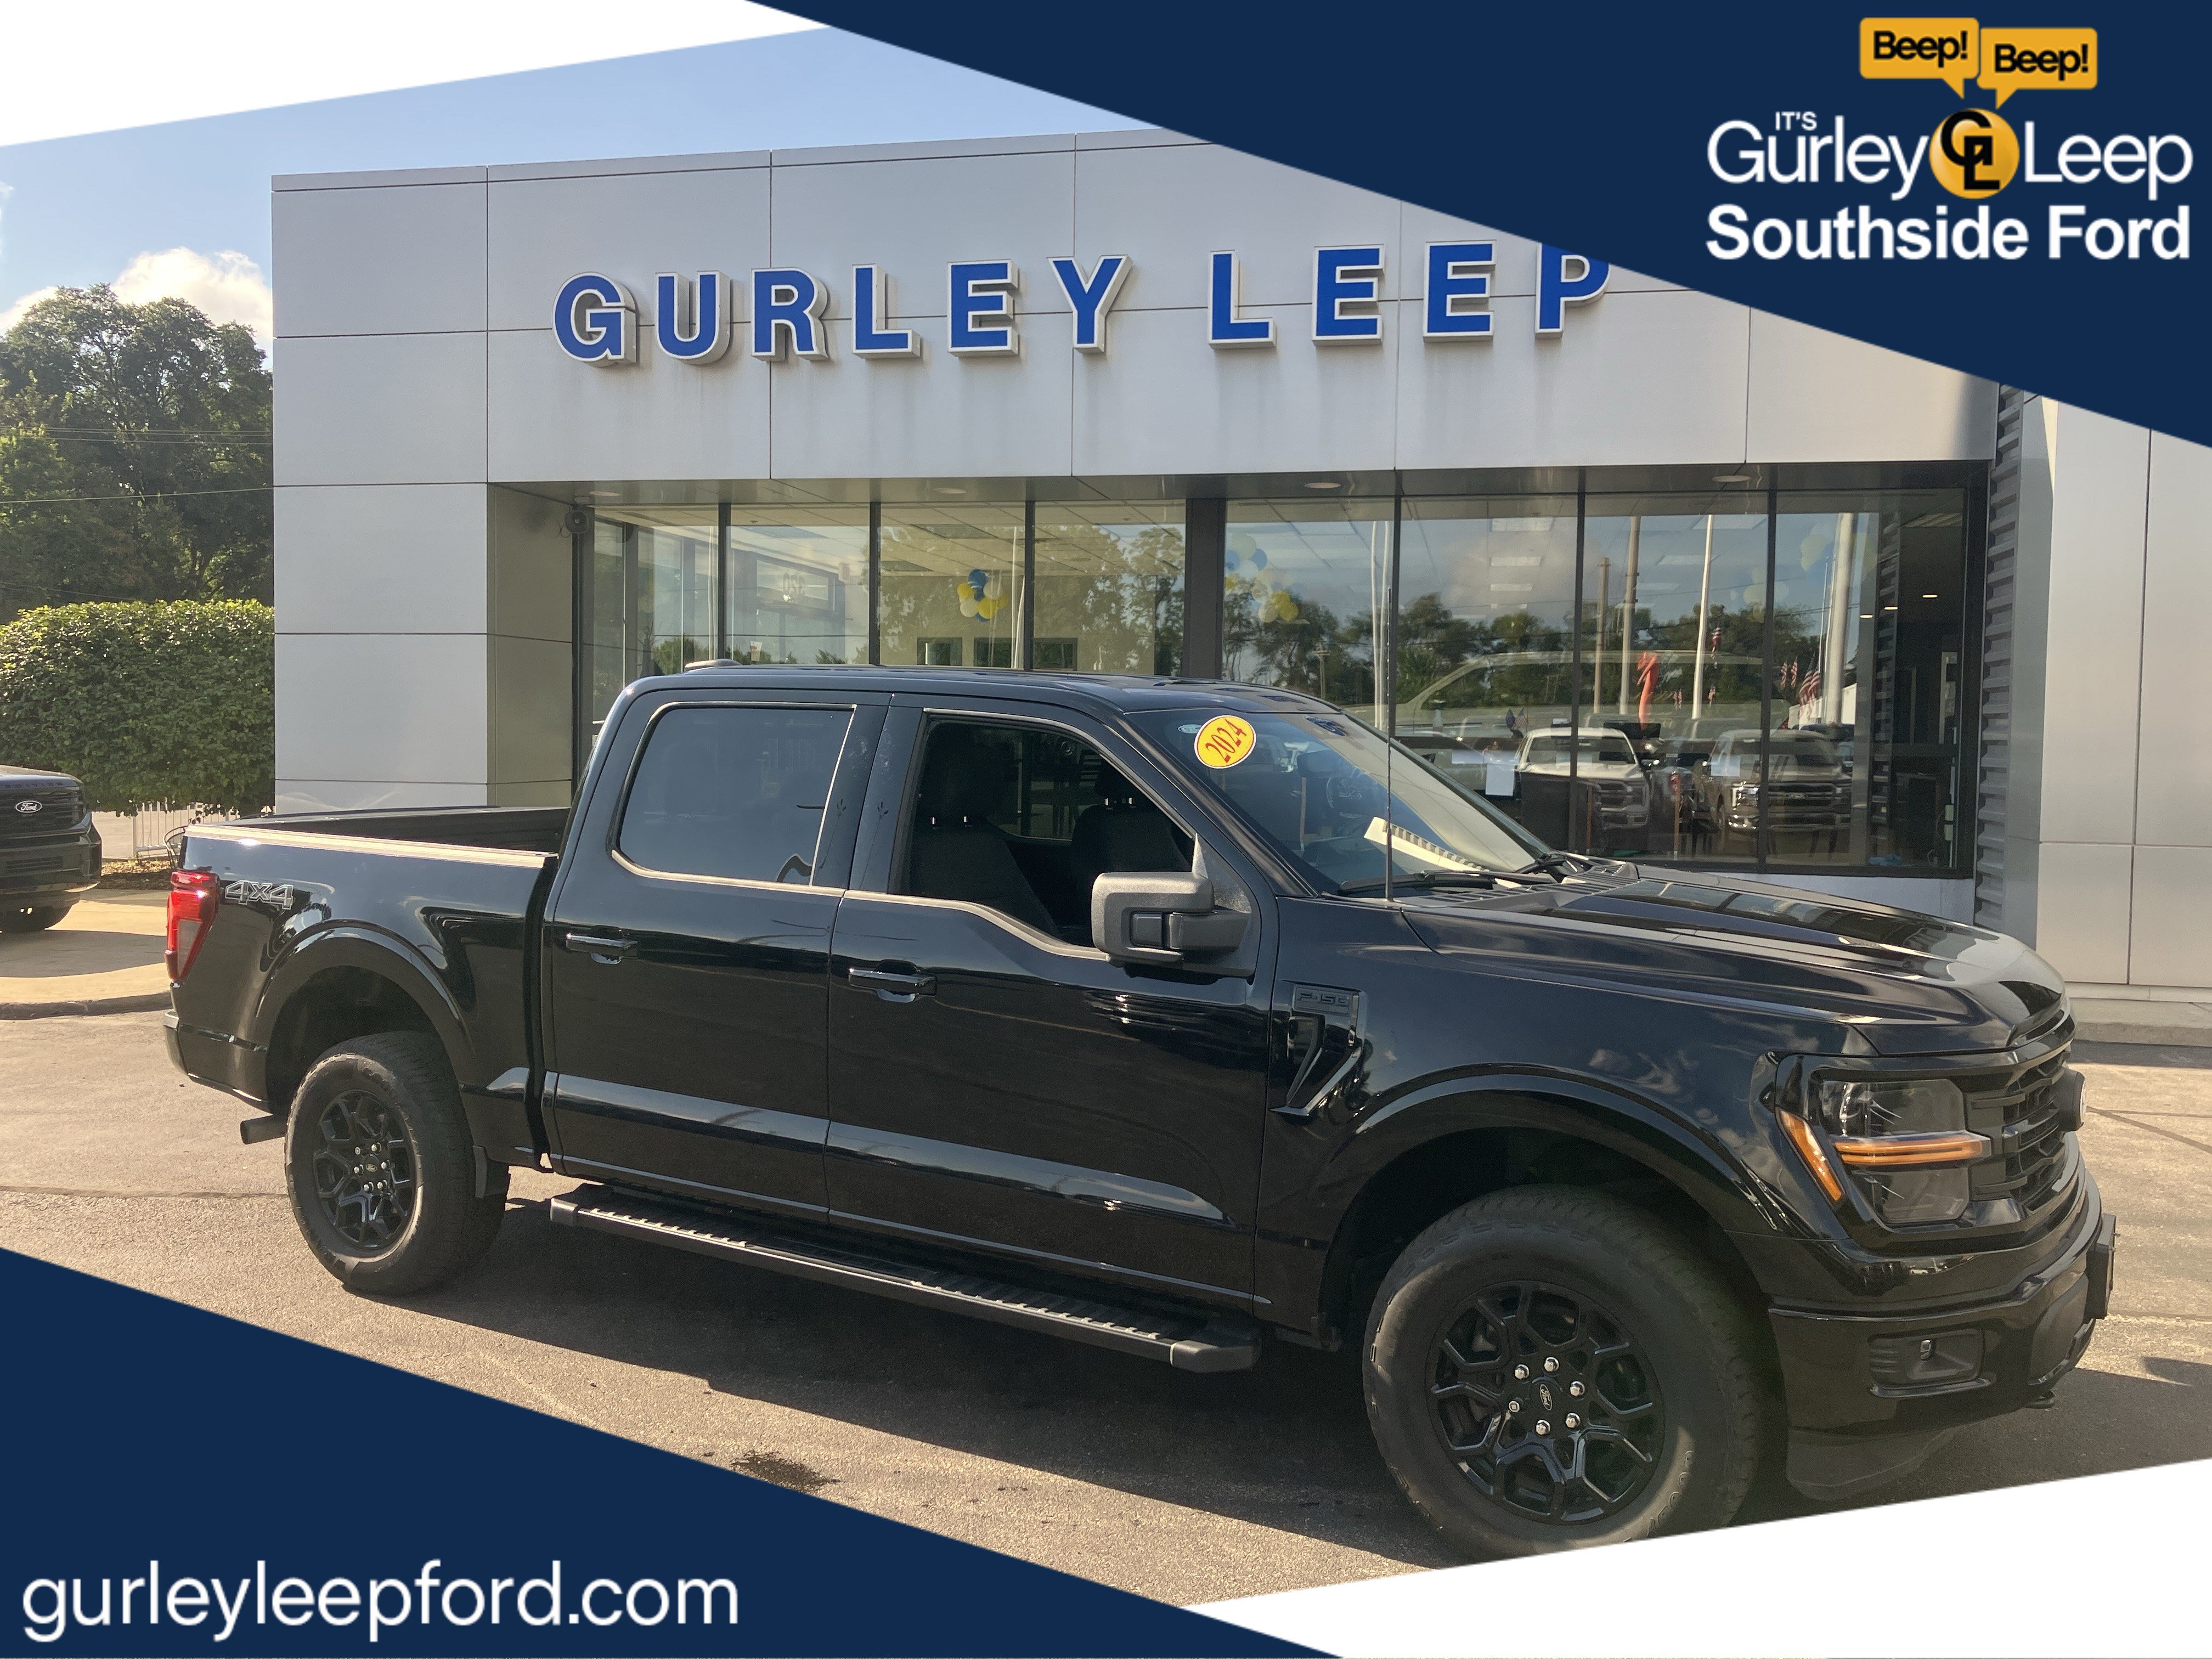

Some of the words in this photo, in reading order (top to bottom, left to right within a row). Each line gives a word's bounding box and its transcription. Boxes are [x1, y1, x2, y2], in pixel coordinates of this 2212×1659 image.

[552, 254, 1133, 366] GURLEY
[1207, 240, 1611, 350] LEEP
[1205, 718, 1248, 764] 2024
[20, 802, 38, 811] Ford
[1540, 1386, 1551, 1408] Ford
